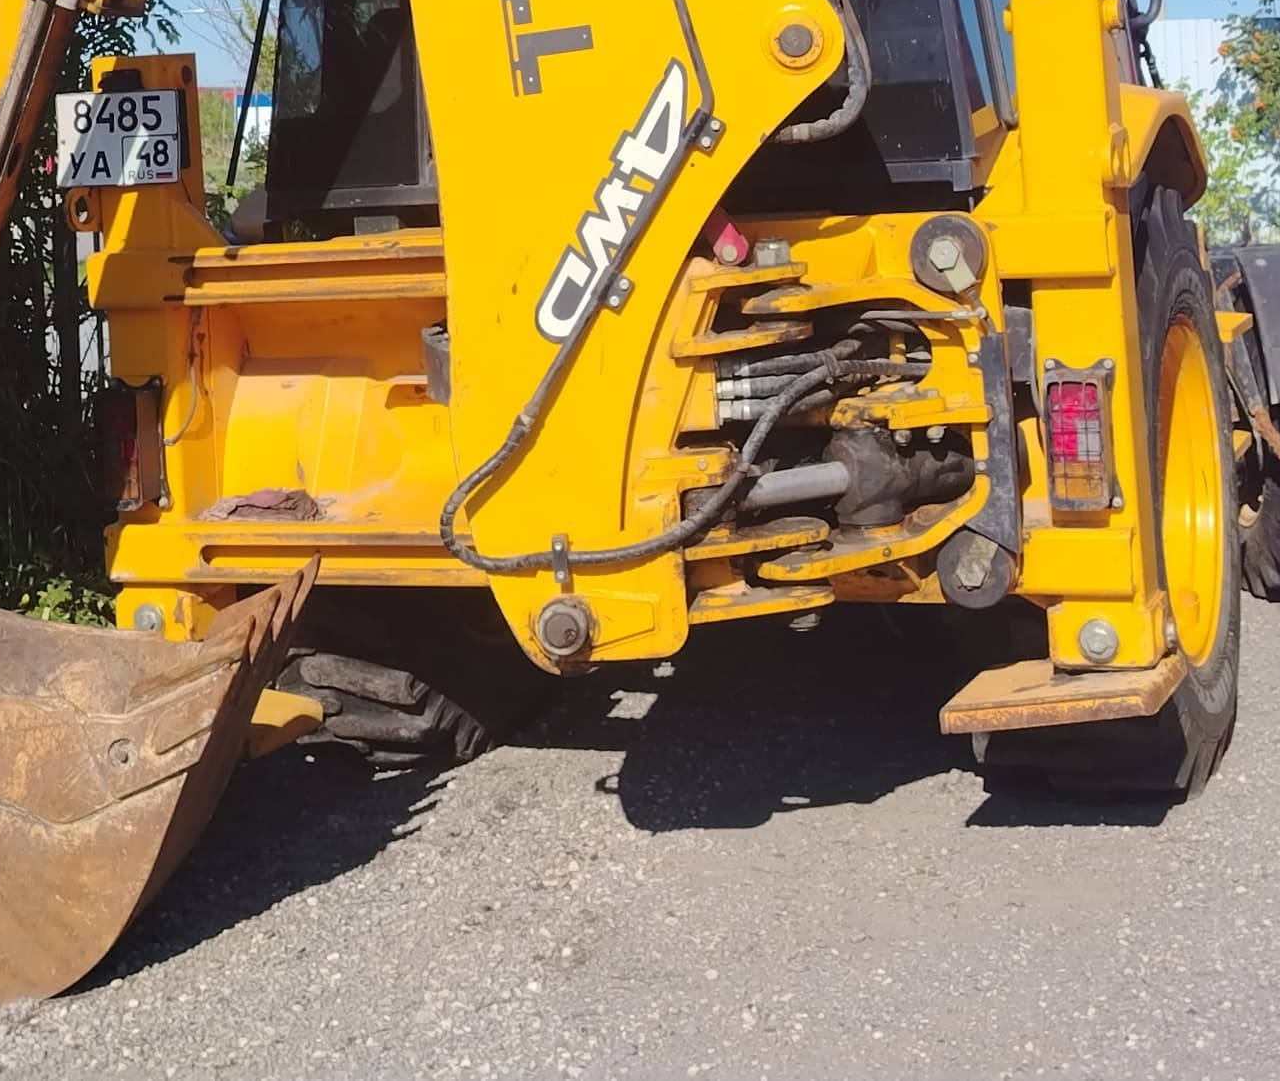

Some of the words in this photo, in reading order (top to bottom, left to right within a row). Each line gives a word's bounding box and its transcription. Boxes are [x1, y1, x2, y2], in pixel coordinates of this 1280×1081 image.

[73, 95, 162, 134] 8485
[136, 139, 169, 168] 48
[128, 170, 154, 180] RUS
[536, 60, 687, 341] 4WD
